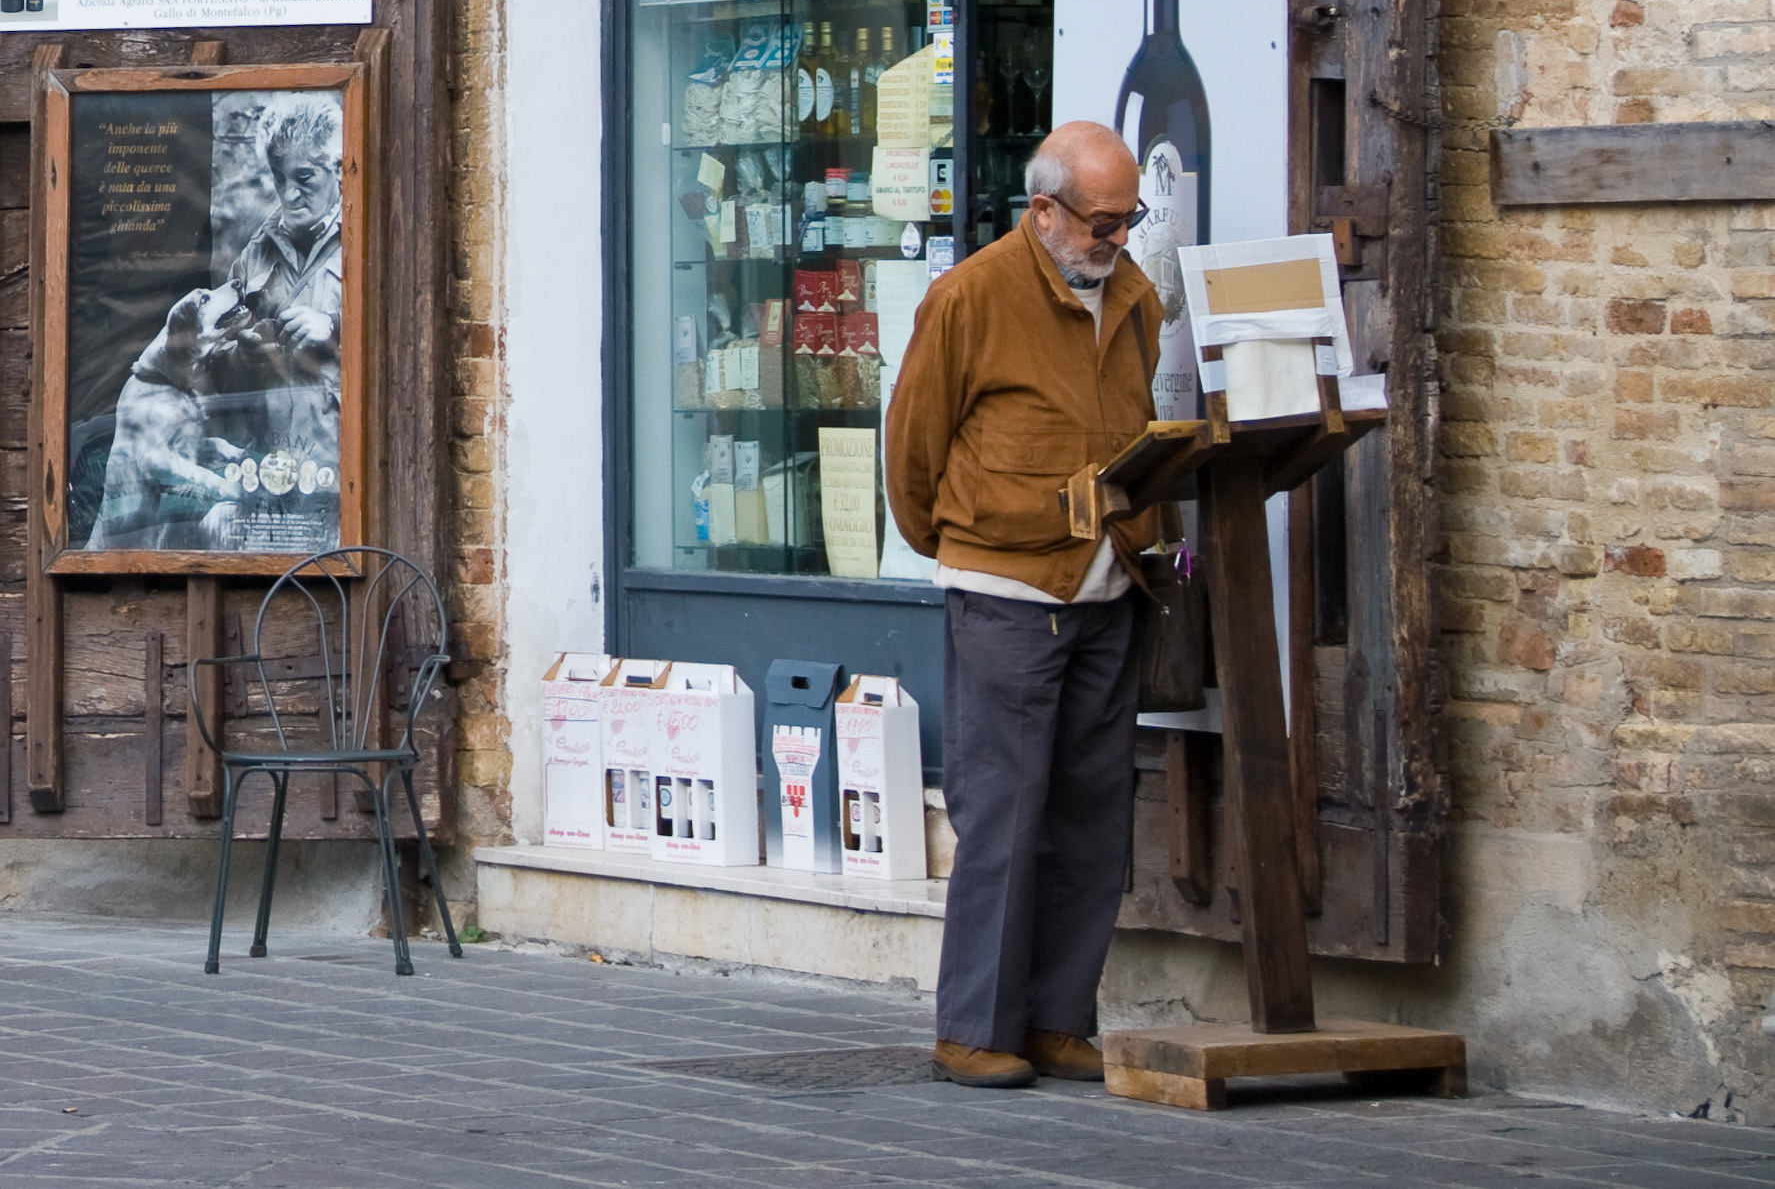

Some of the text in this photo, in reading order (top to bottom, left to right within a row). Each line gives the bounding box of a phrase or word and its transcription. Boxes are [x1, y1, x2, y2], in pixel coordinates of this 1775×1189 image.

[153, 7, 184, 20] Gallo
[186, 6, 198, 19] di
[201, 4, 261, 18] Montefalco
[157, 121, 179, 138] più
[107, 142, 169, 158] imponente
[103, 161, 174, 177] delle querce
[98, 180, 178, 194] è nata da una
[101, 199, 173, 216] piccolissima
[1153, 363, 1193, 402] avergine
[820, 436, 874, 458] PROMOZIONE
